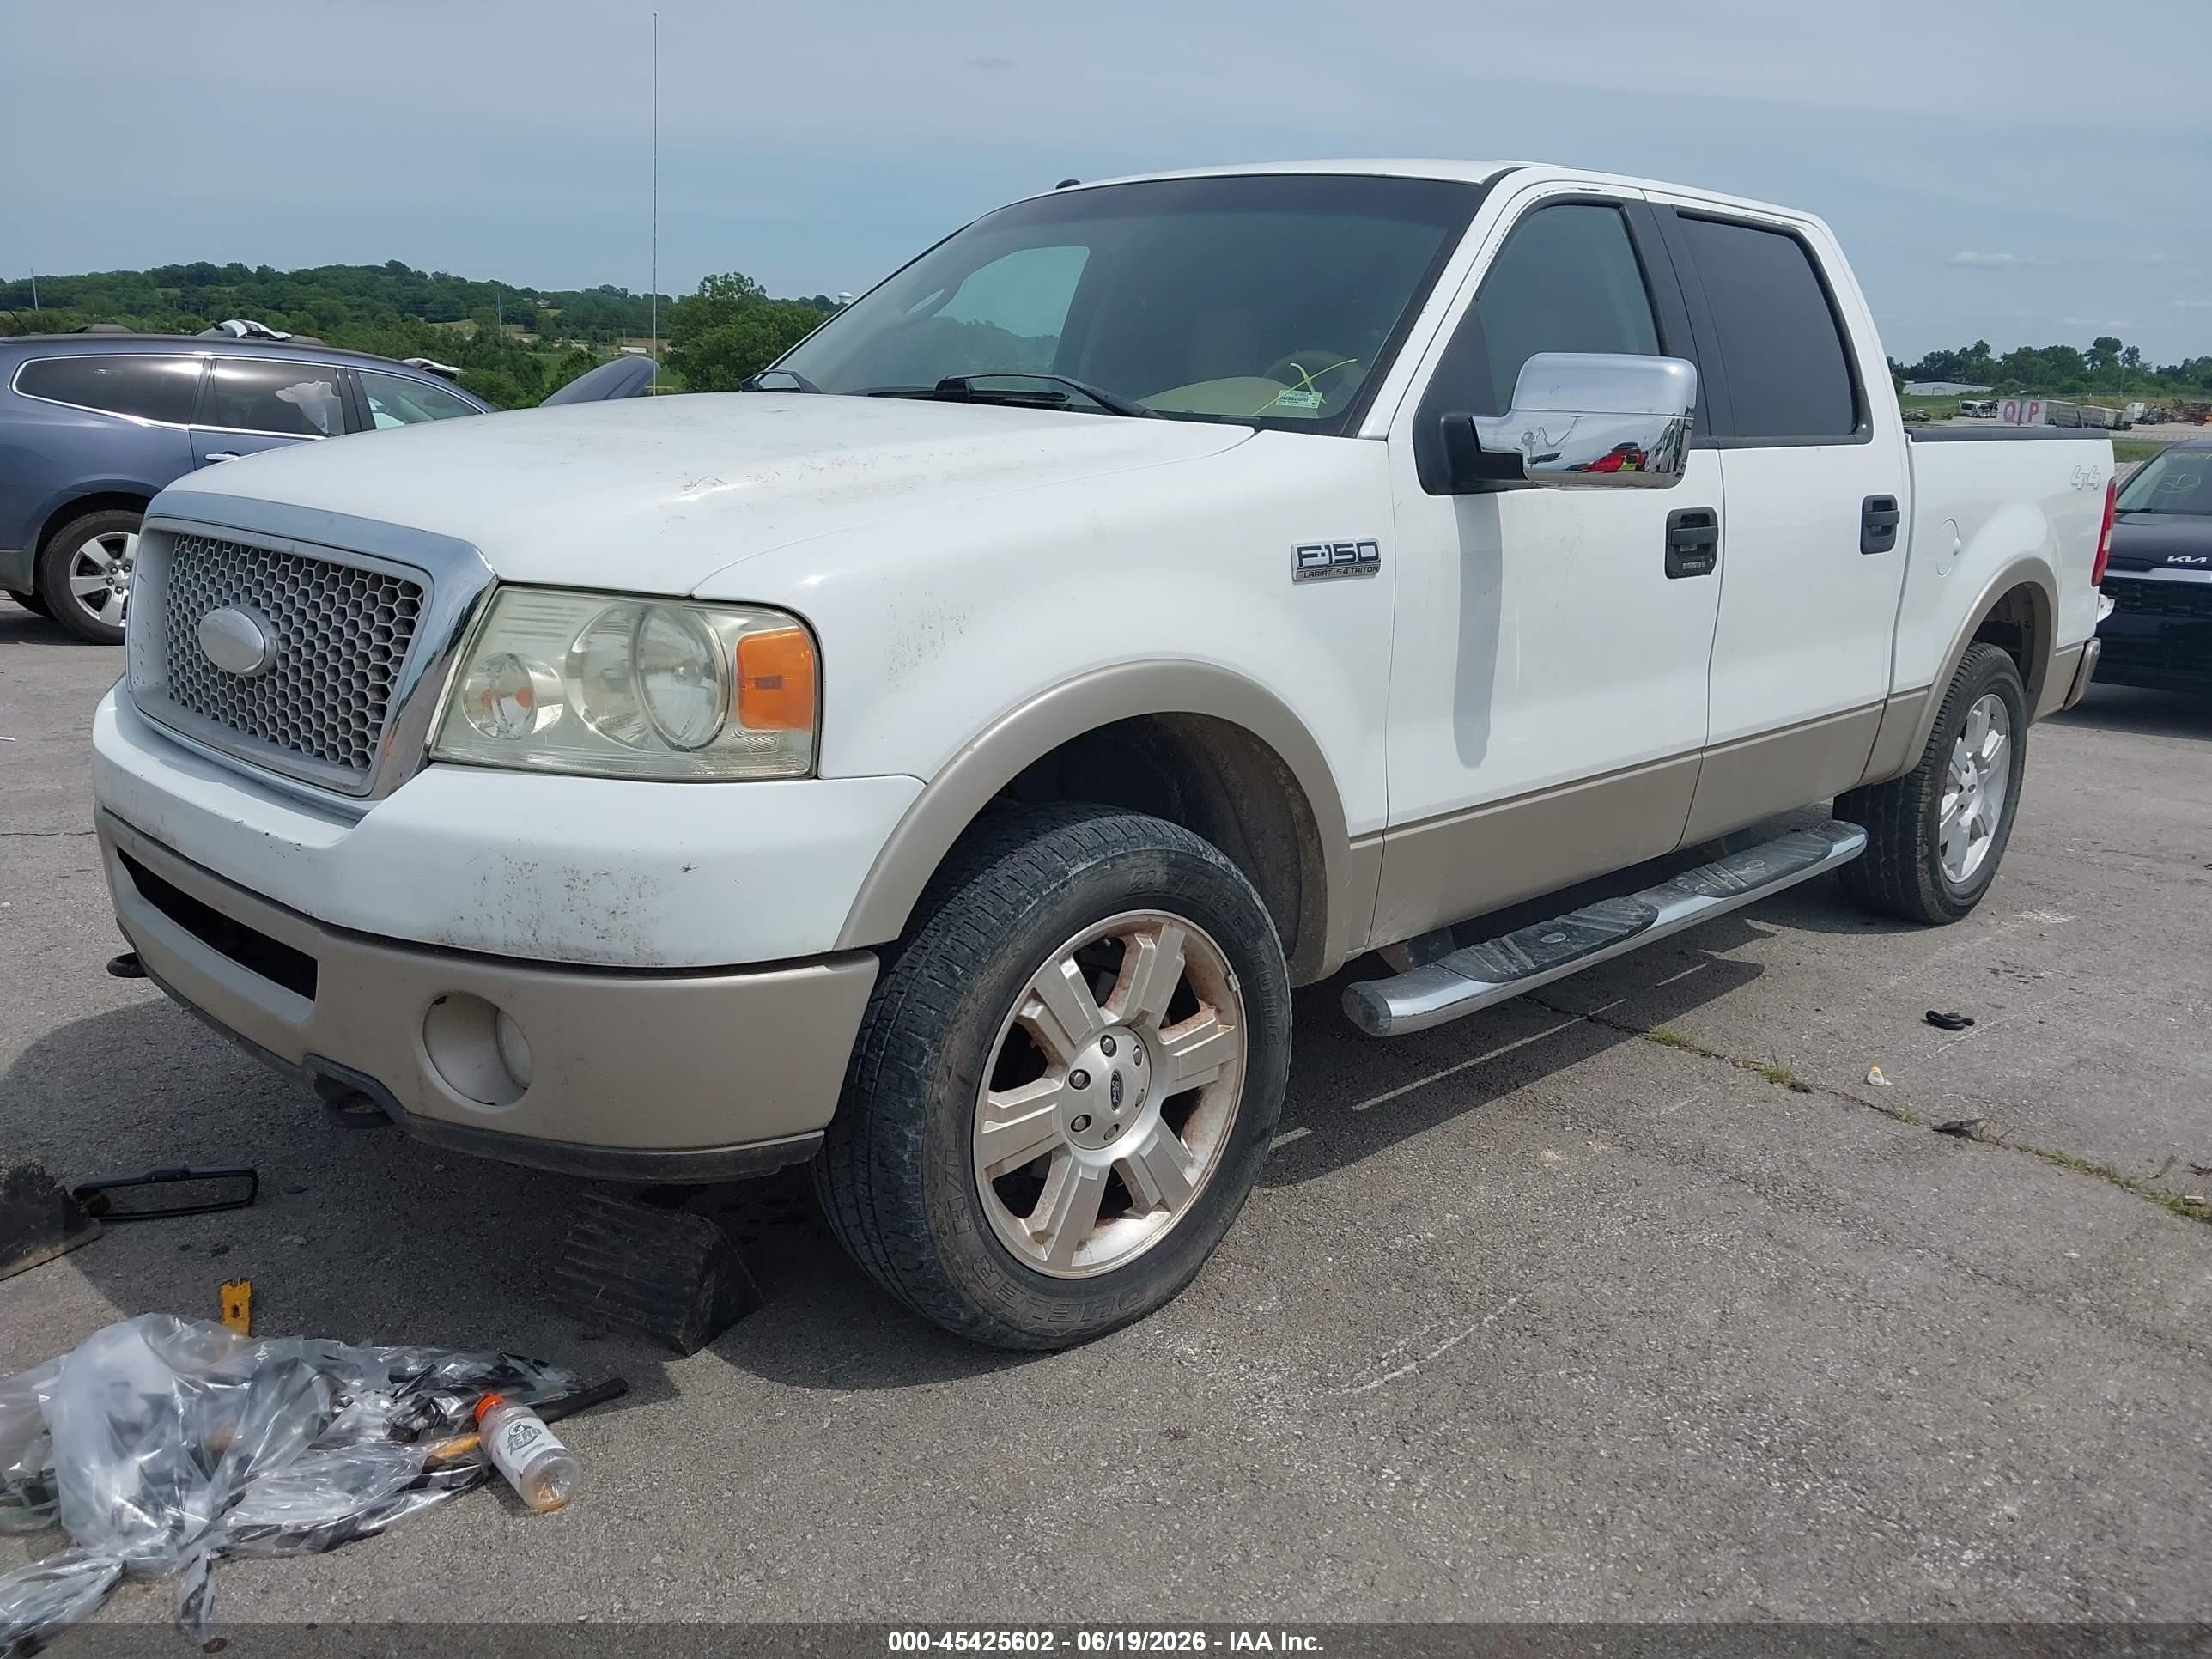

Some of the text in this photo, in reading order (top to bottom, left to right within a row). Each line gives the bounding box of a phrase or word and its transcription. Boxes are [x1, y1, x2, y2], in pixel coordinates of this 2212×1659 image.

[2003, 400, 2039, 423] Q P
[1297, 541, 1379, 568] F-150
[1304, 569, 1333, 578] LARIAT
[1351, 565, 1379, 574] TRITON
